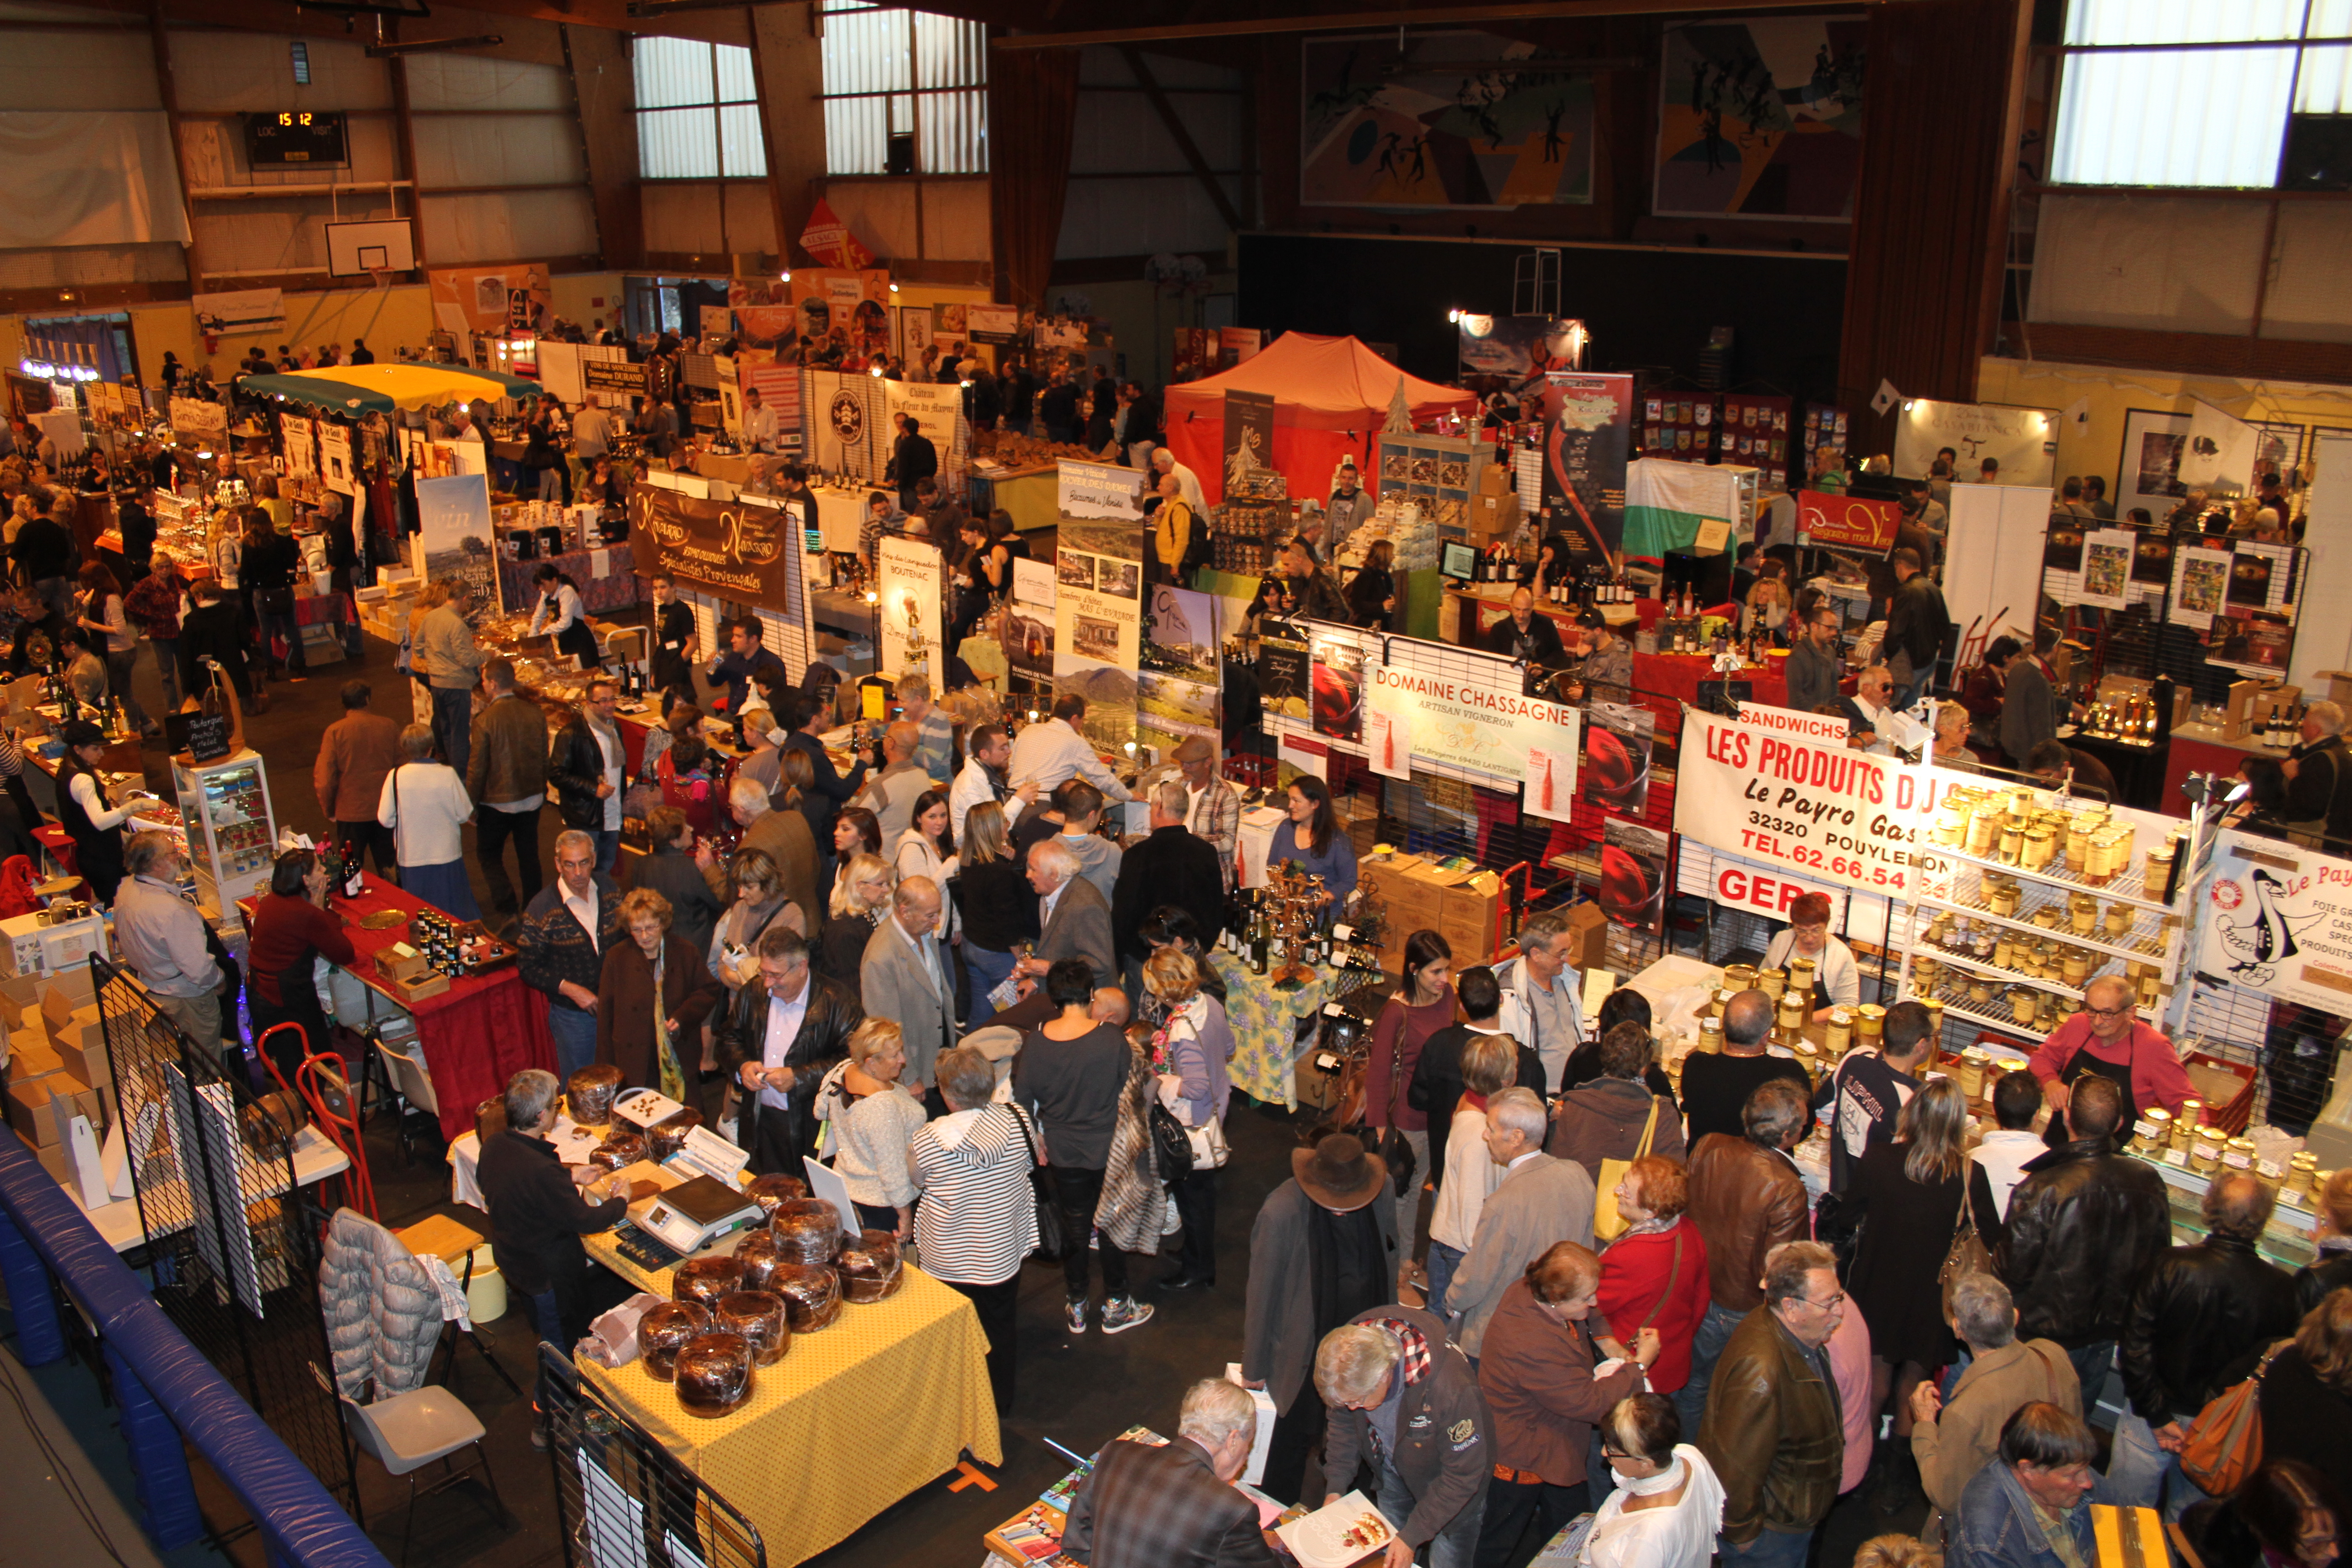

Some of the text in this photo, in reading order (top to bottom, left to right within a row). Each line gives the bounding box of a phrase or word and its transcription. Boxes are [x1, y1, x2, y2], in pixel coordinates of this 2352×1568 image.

[279, 113, 312, 126] 15 12
[588, 369, 645, 382] Domaine DURAND
[611, 364, 640, 373] SANCERRE
[909, 388, 935, 399] Château
[1059, 464, 1108, 479] Domaine Viticole
[1088, 479, 1103, 490] DES
[1105, 481, 1132, 494] DAMES
[1068, 490, 1096, 504] Beaumes
[1102, 495, 1123, 508] Venise
[881, 551, 939, 570] Vins du Languedoc
[659, 551, 761, 589] Spécialités Provençales
[891, 565, 929, 581] BOUTENAC
[1057, 589, 1081, 602] Chambres
[1083, 594, 1102, 606] d'hôtes
[1078, 603, 1093, 613] MAS
[1012, 665, 1033, 676] BEAUMES
[1040, 673, 1054, 682] VENIS
[1377, 669, 1569, 726] DOMAINE CHASSAGNE
[1418, 700, 1514, 728] ARTISAN VIGNERON
[1137, 715, 1154, 725] uscat
[1161, 720, 1187, 733] Beaumes
[1196, 728, 1218, 739] Venise
[1740, 709, 1845, 740] SANDWICHS
[1458, 756, 1480, 767] 69430
[1482, 761, 1521, 777] LANTIGNIE
[1706, 725, 1750, 769] LES
[1758, 737, 1884, 805] PRODUITS
[1896, 774, 1936, 813] DU
[1744, 778, 1769, 803] Le
[1778, 787, 1856, 826] Payro
[1749, 811, 1948, 874] 32320 POUYLEON
[2212, 879, 2242, 901] PRODUITS
[2286, 875, 2310, 898] Le
[2214, 898, 2235, 910] GERS
[2313, 900, 2337, 914] FOIE
[2300, 938, 2352, 960] PRODUITS
[2313, 959, 2343, 973] Colette
